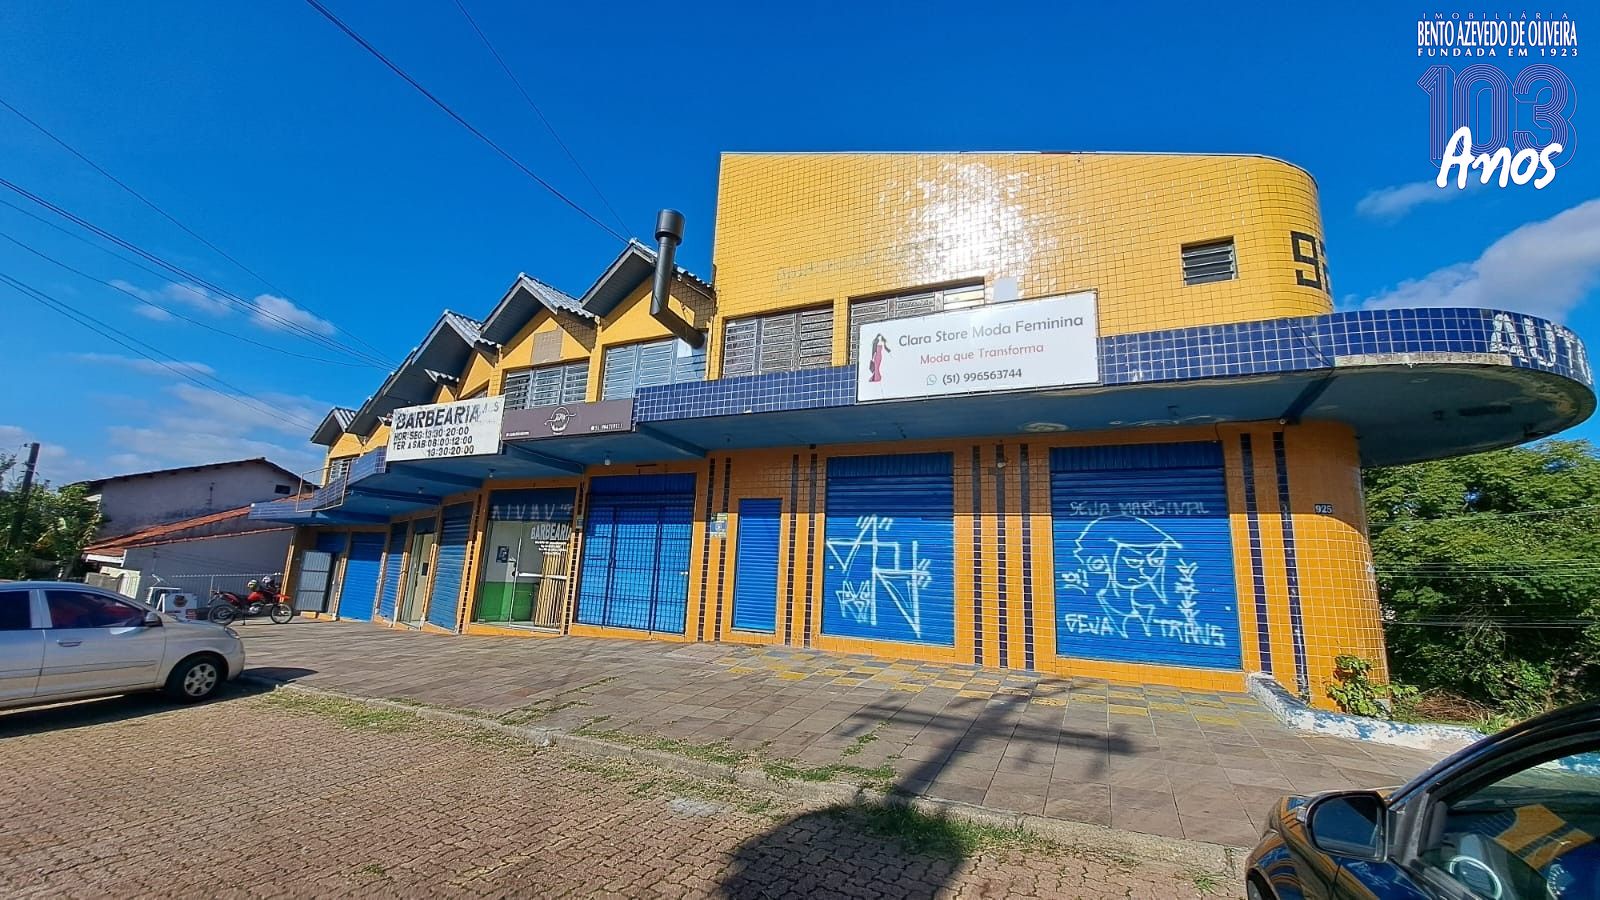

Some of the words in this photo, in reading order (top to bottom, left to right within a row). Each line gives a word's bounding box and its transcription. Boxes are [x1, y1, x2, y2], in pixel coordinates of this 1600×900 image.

[898, 334, 932, 347] Clara
[935, 330, 968, 343] Store
[972, 323, 1011, 339] Moda
[1015, 316, 1084, 334] Feminina
[920, 353, 950, 365] Moda
[953, 351, 974, 362] que
[978, 344, 1044, 358] Transforma
[942, 372, 960, 386] (51)
[963, 368, 1022, 382] 996563744
[395, 404, 480, 430] BARBEARIA
[393, 440, 406, 450] TER
[412, 439, 426, 449] SAB
[1315, 504, 1333, 514] 925
